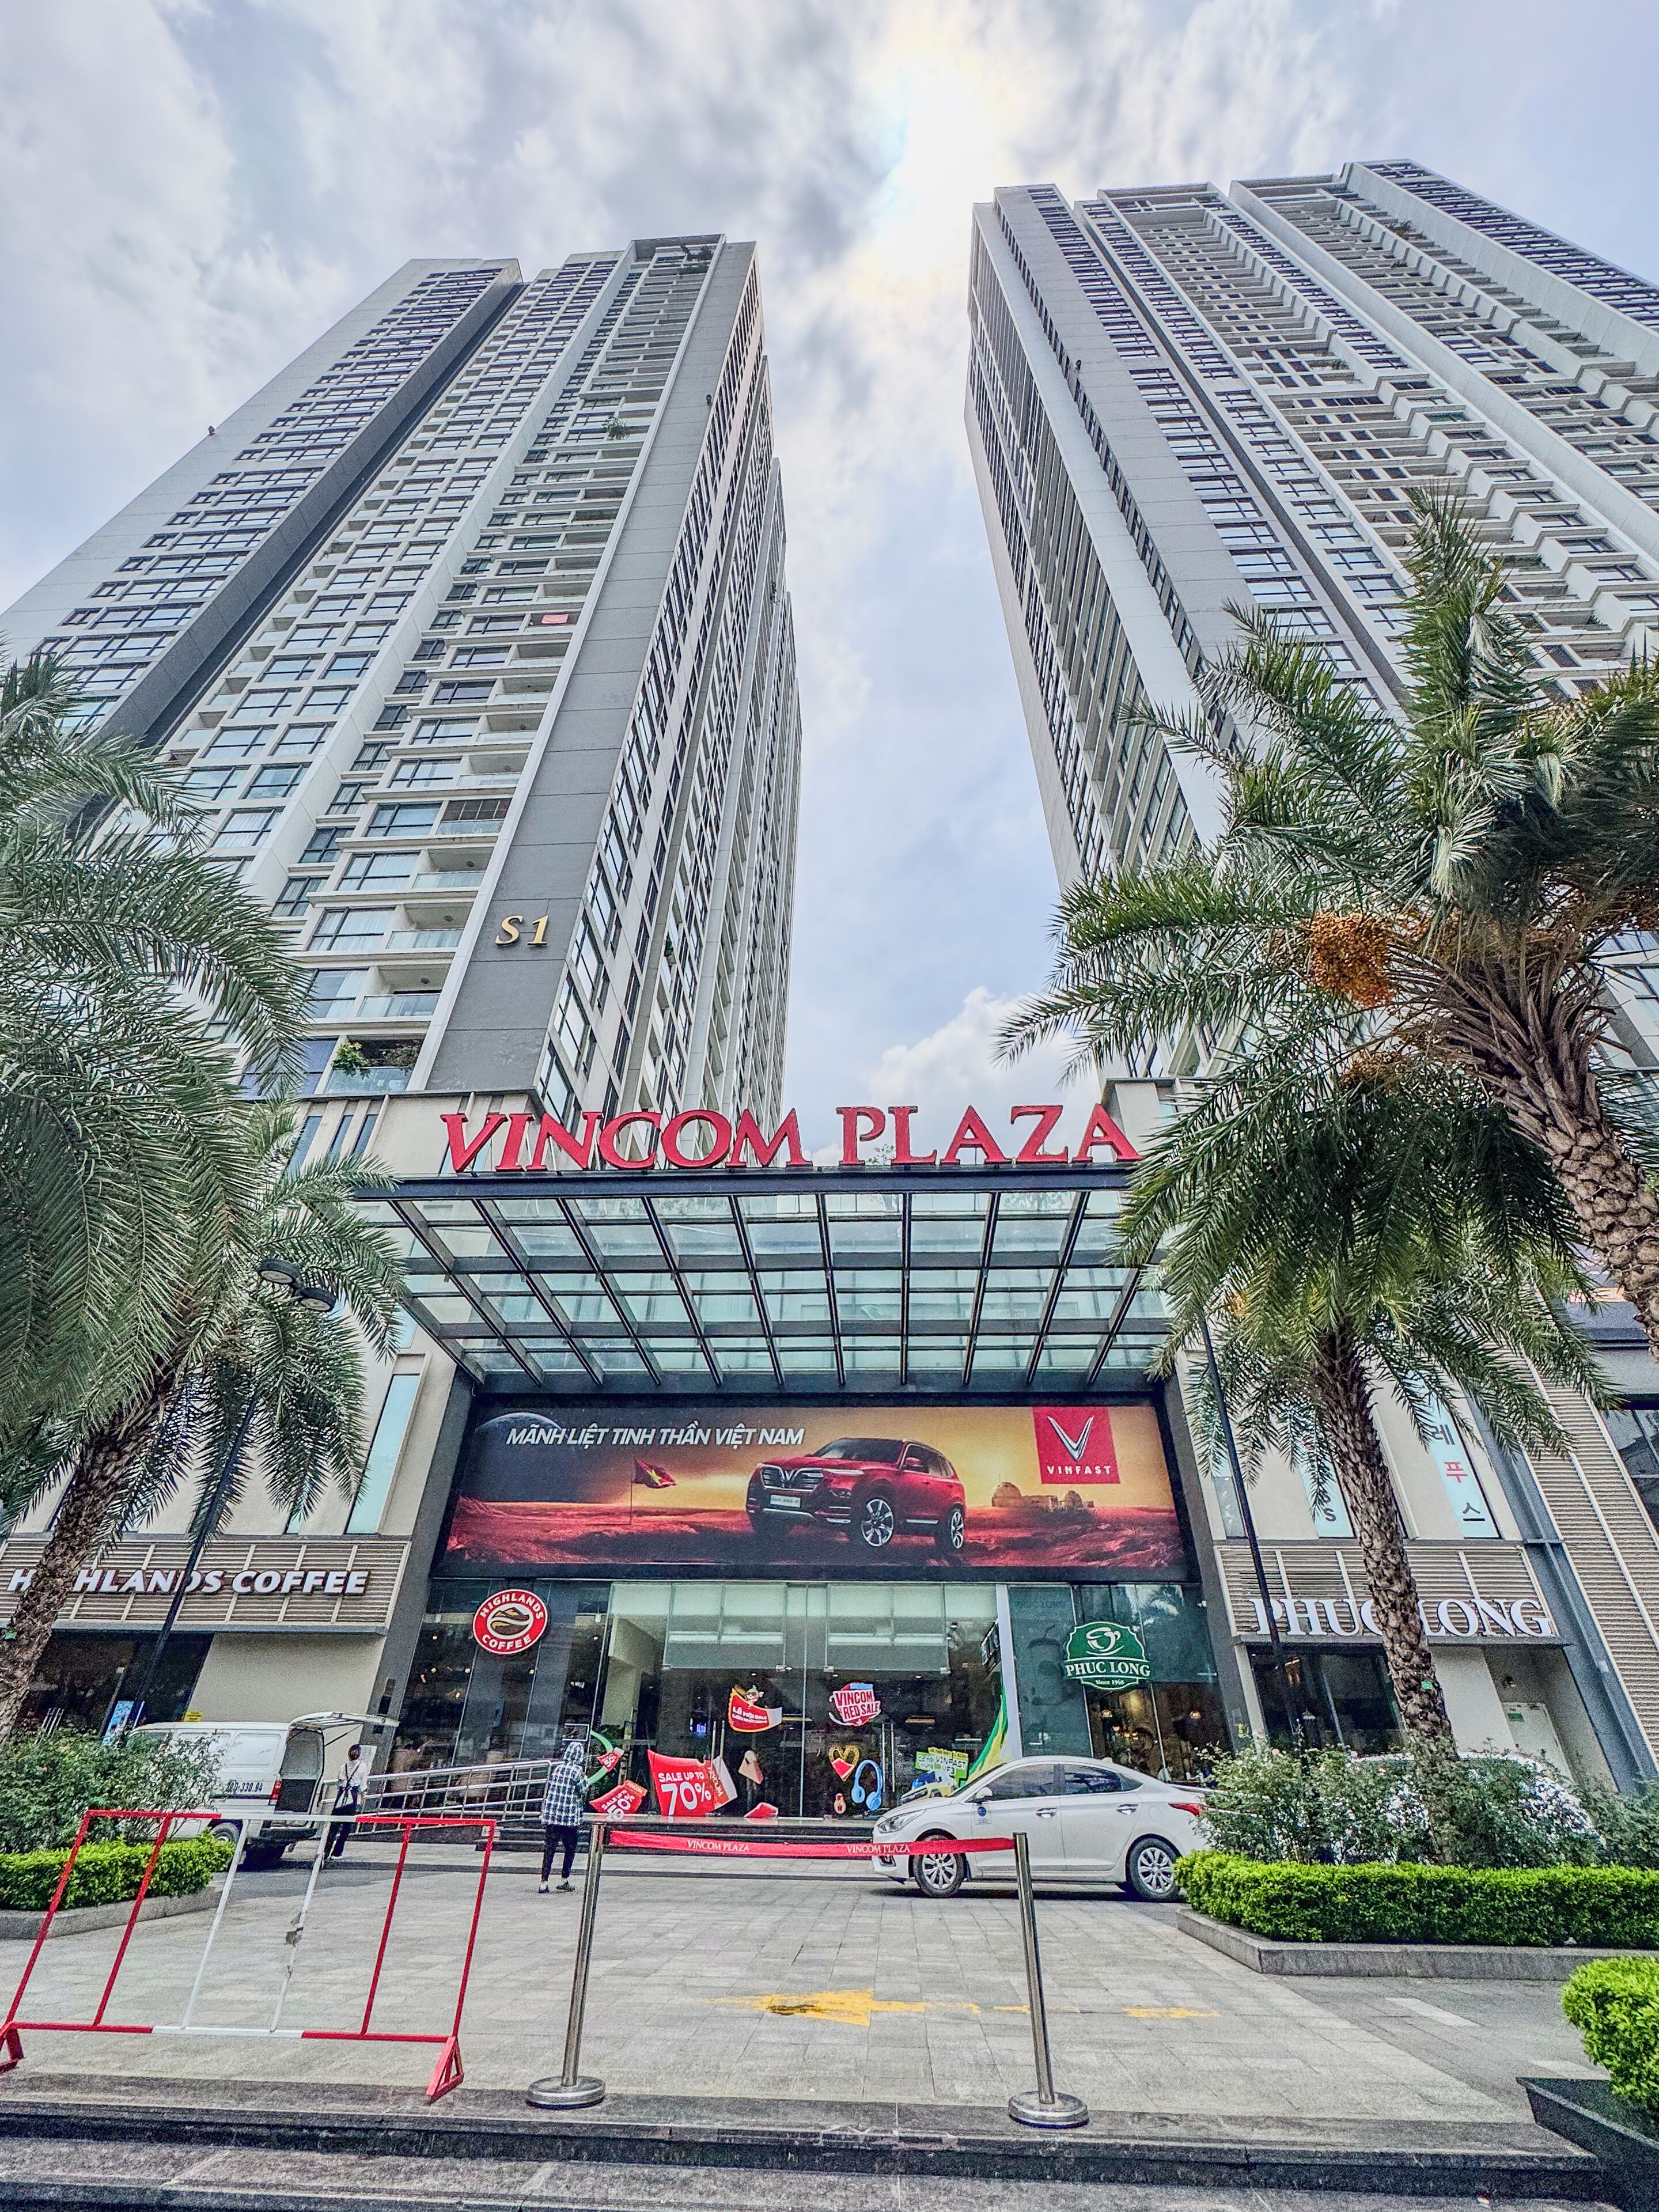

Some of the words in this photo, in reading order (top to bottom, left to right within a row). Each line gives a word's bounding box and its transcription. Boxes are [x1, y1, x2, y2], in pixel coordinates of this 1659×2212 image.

[495, 915, 548, 945] S1
[440, 1107, 813, 1172] VINCOM
[836, 1104, 1143, 1166] PLAZA
[505, 1423, 566, 1445] MÃNH
[567, 1423, 608, 1449] LIỆT
[611, 1428, 653, 1445] TINH
[659, 1420, 710, 1445] THẦN
[715, 1423, 757, 1449] VIỆT
[757, 1428, 804, 1445] NAM
[1047, 1465, 1111, 1475] VINFAST
[6, 1569, 224, 1593] HHLANDS
[232, 1570, 369, 1594] COFFEE
[479, 1593, 544, 1620] HIGHLANDS
[482, 1634, 532, 1650] COFFEE
[1065, 1661, 1107, 1677] PHUC
[1109, 1661, 1151, 1677] LONG
[835, 1691, 873, 1706] VINCOM
[843, 1705, 861, 1719] RED
[861, 1702, 878, 1715] SALE
[935, 1756, 966, 1768] VINFAST
[658, 1772, 683, 1783] SALE
[683, 1771, 694, 1781] UP
[694, 1771, 704, 1780] TO
[661, 1781, 711, 1816] 70%
[687, 1839, 721, 1851] VINCOM
[722, 1842, 749, 1852] PLAZA
[847, 1844, 882, 1854] VINCOM
[883, 1844, 911, 1853] PLAZA
